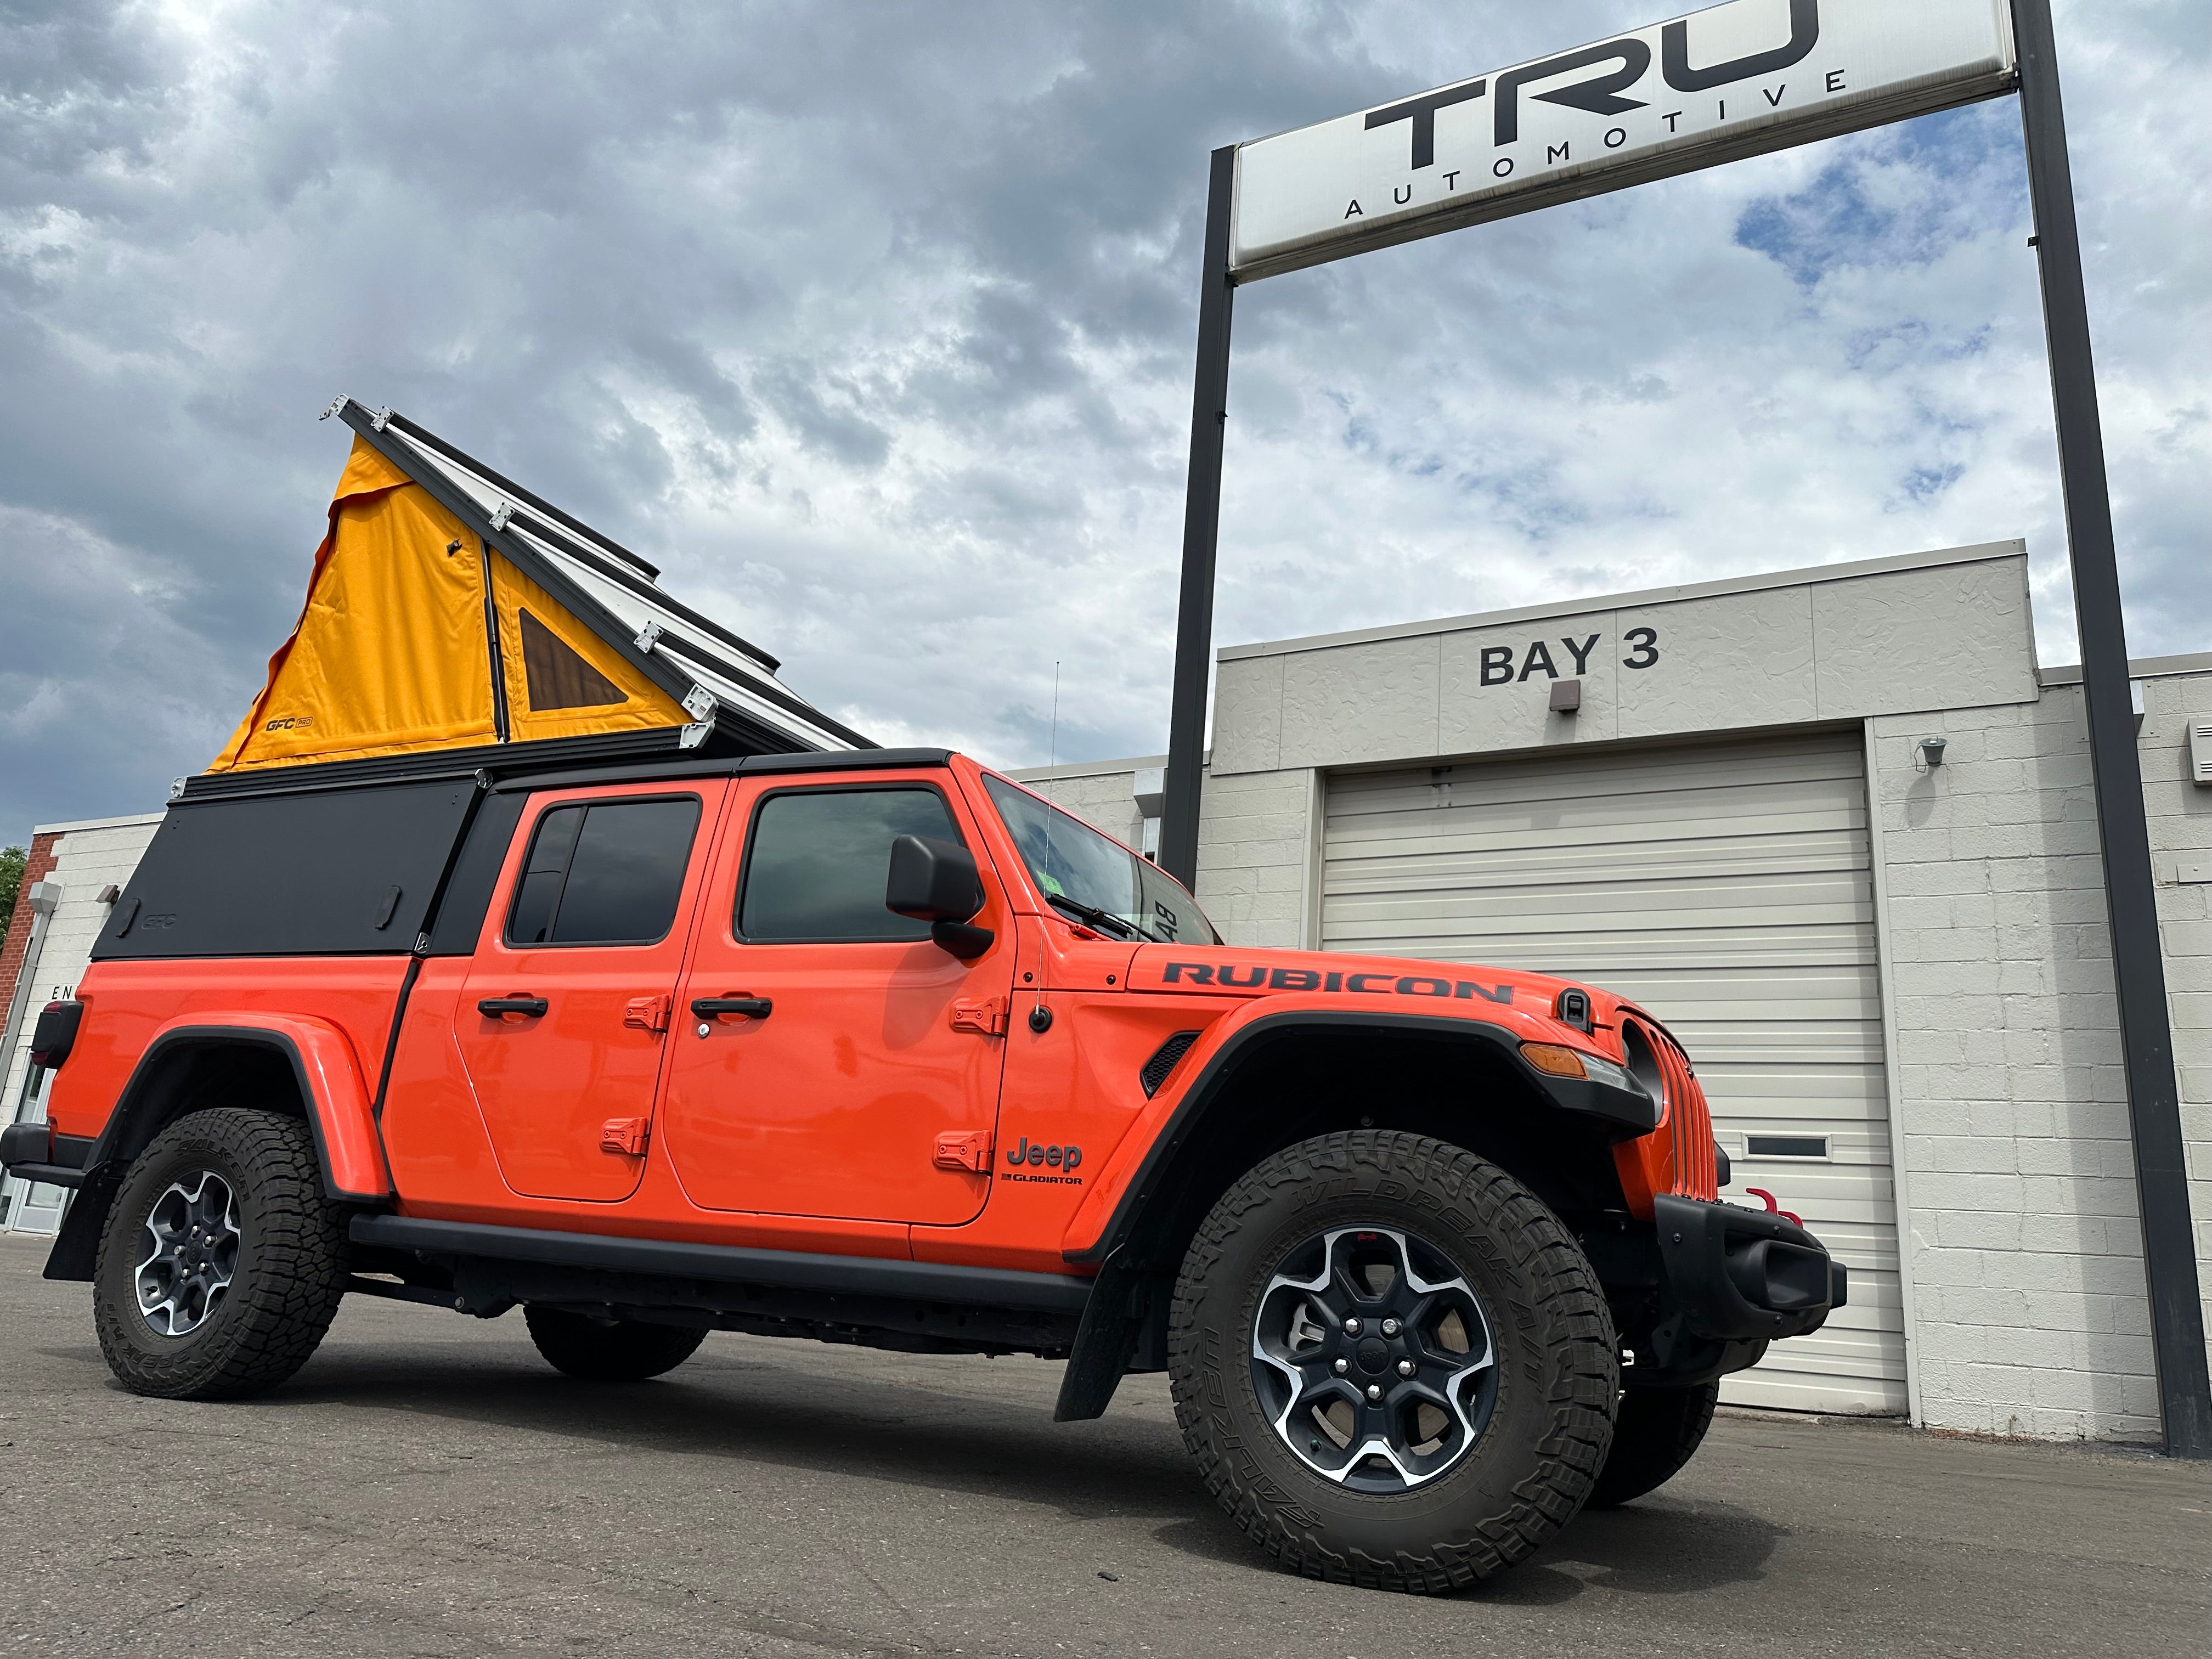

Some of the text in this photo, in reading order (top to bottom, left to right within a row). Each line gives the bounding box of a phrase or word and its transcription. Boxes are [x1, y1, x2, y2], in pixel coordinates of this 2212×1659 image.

[1364, 0, 1820, 171] TRU
[1344, 69, 1847, 220] AUTOMOTIVE
[1480, 627, 1659, 687] BAY 3
[266, 717, 295, 731] GFC
[141, 913, 177, 930] GFC
[52, 985, 72, 1000] EN
[1162, 962, 1515, 1005] RUBICON
[1007, 1136, 1082, 1172] Jeep
[1013, 1173, 1083, 1185] GLADIATOR
[1290, 1176, 1522, 1289] WILDPEAK
